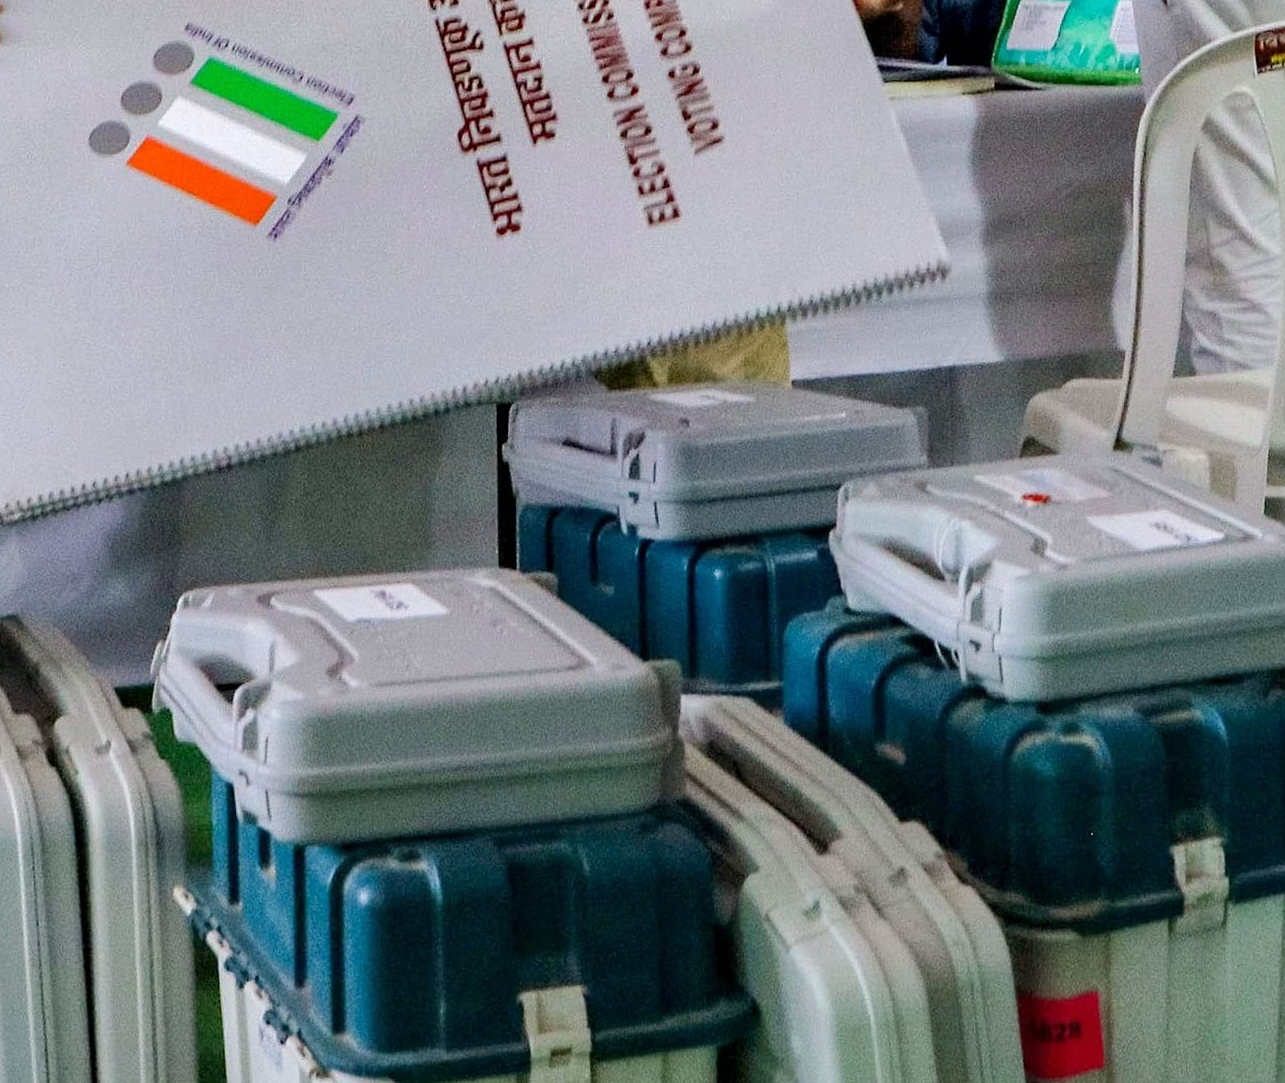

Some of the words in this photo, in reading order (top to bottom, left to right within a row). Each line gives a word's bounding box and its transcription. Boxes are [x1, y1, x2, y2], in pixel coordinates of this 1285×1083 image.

[435, 15, 503, 154] निवडणूक
[504, 37, 558, 146] मतदान
[668, 62, 725, 156] VOTING
[476, 153, 523, 238] भारत
[614, 105, 680, 227] ELECTION
